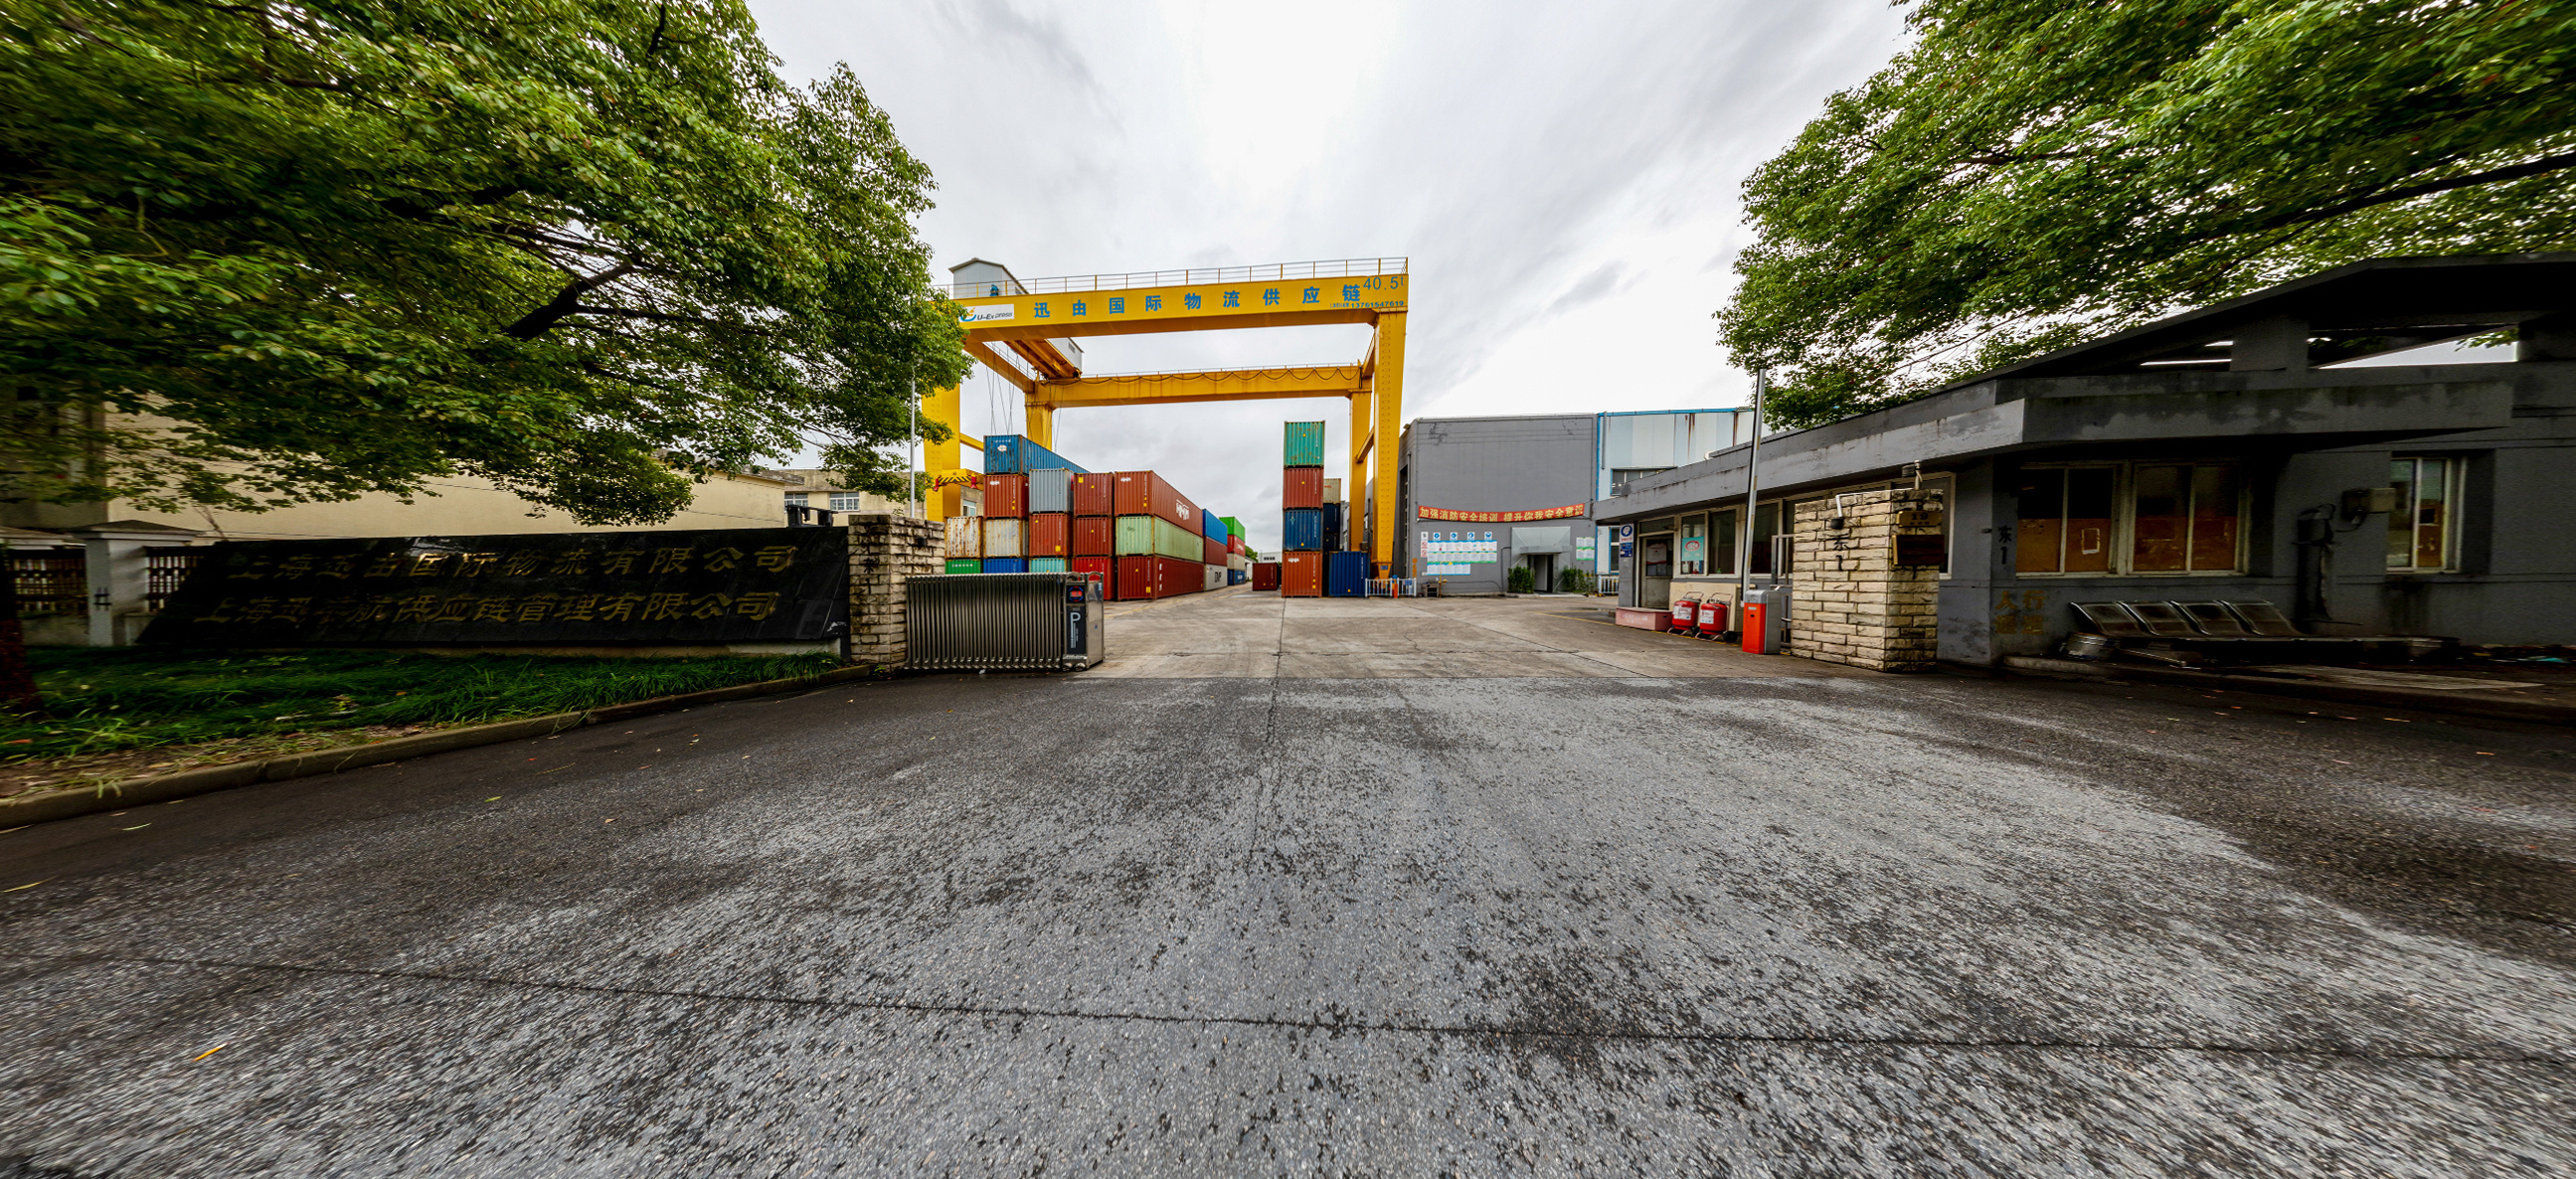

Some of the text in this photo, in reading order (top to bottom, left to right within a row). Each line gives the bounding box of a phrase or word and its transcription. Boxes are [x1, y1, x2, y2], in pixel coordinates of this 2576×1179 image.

[1033, 283, 1361, 319] 迅由国际物流供应链
[1420, 504, 1584, 522] 加强消防安全培训 提升你我安全意识
[227, 545, 799, 581] 上海迅由国际物流有限公司
